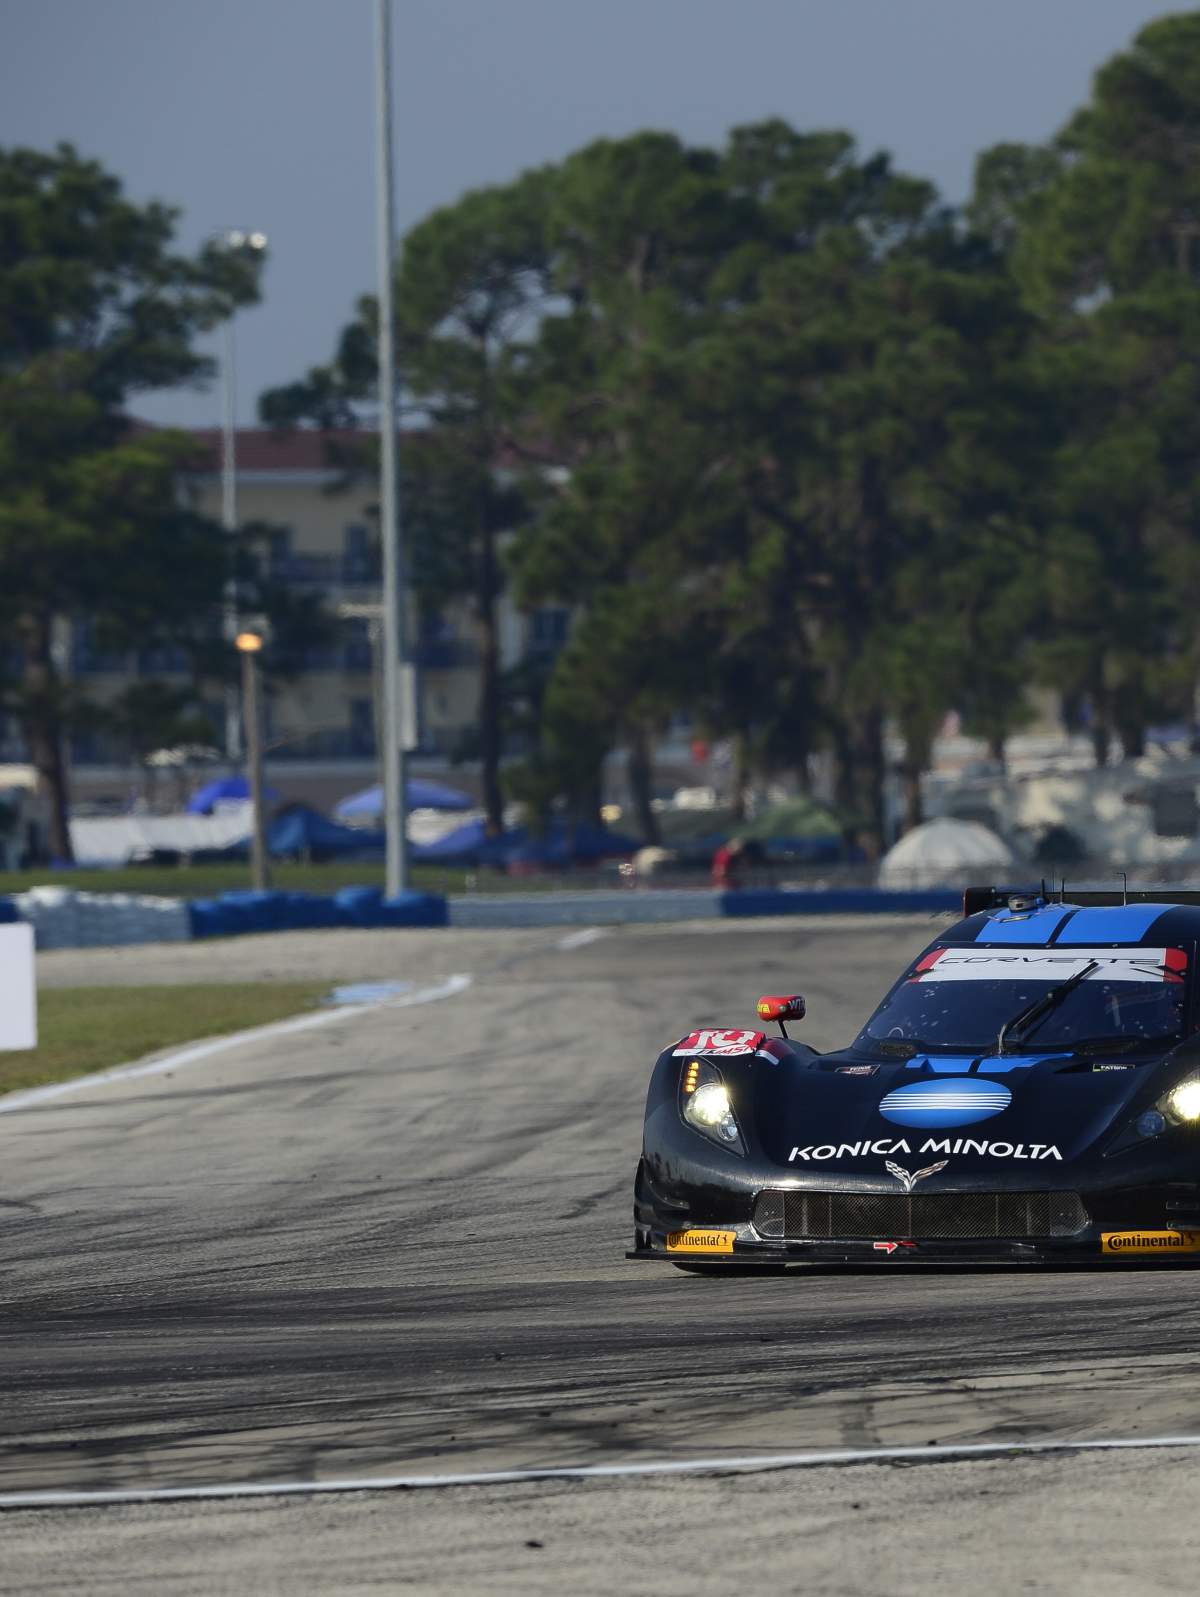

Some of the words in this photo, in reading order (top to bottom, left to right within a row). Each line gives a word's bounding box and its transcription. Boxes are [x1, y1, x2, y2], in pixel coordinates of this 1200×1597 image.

[938, 956, 1160, 966] CORVETTE
[788, 1138, 911, 1162] KONICA
[918, 1138, 1063, 1161] MINOLTA
[668, 1233, 720, 1249] Continental
[1107, 1232, 1184, 1251] Continental
